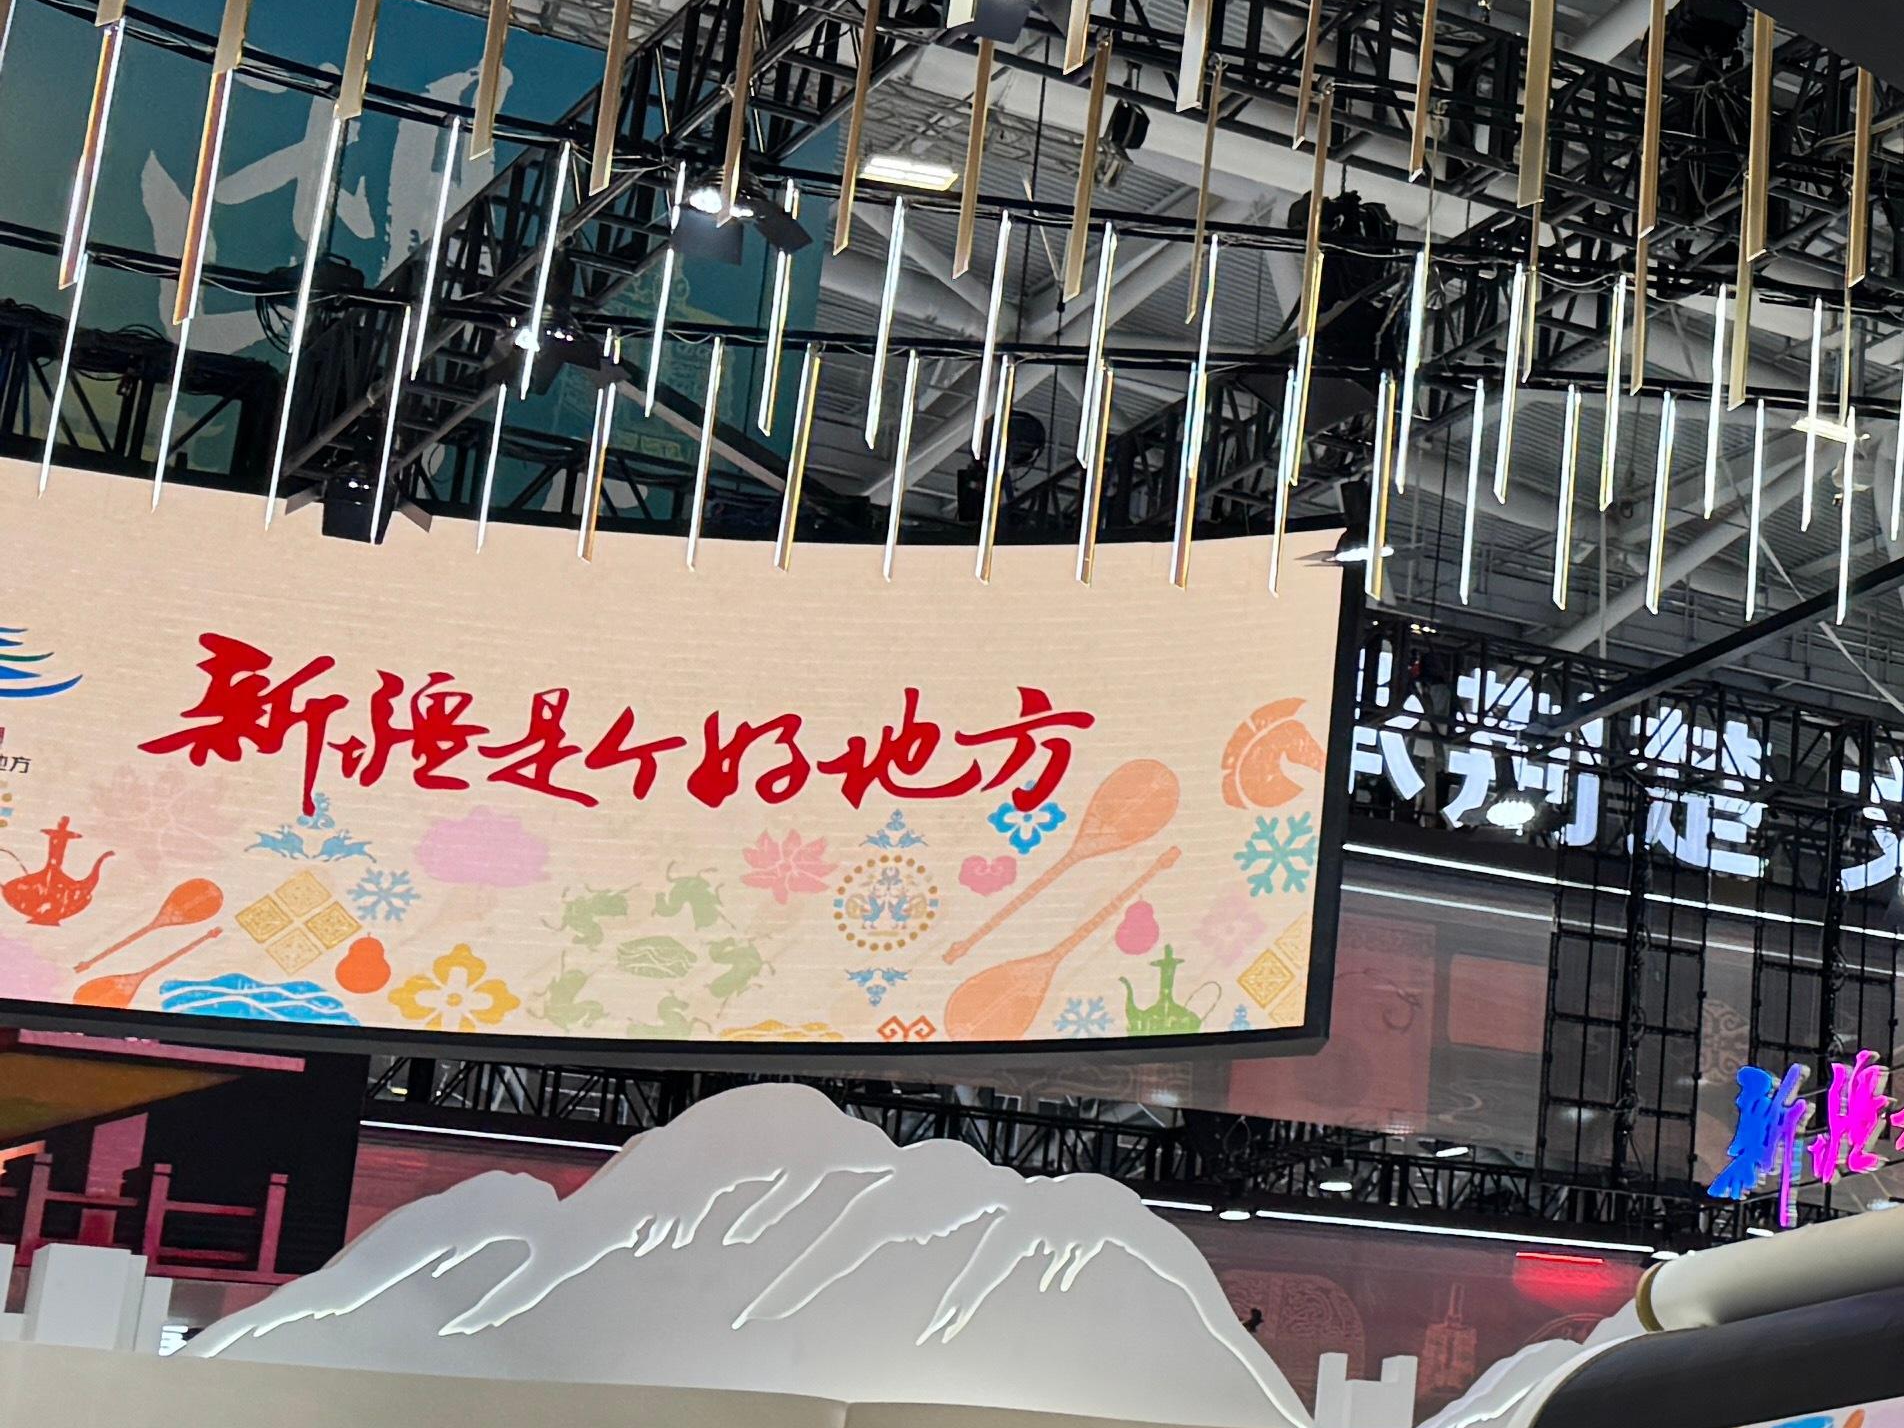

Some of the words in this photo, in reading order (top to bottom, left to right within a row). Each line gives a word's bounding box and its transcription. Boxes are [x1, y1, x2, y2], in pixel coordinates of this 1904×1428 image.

[137, 632, 1095, 817] 新疆是个好地方
